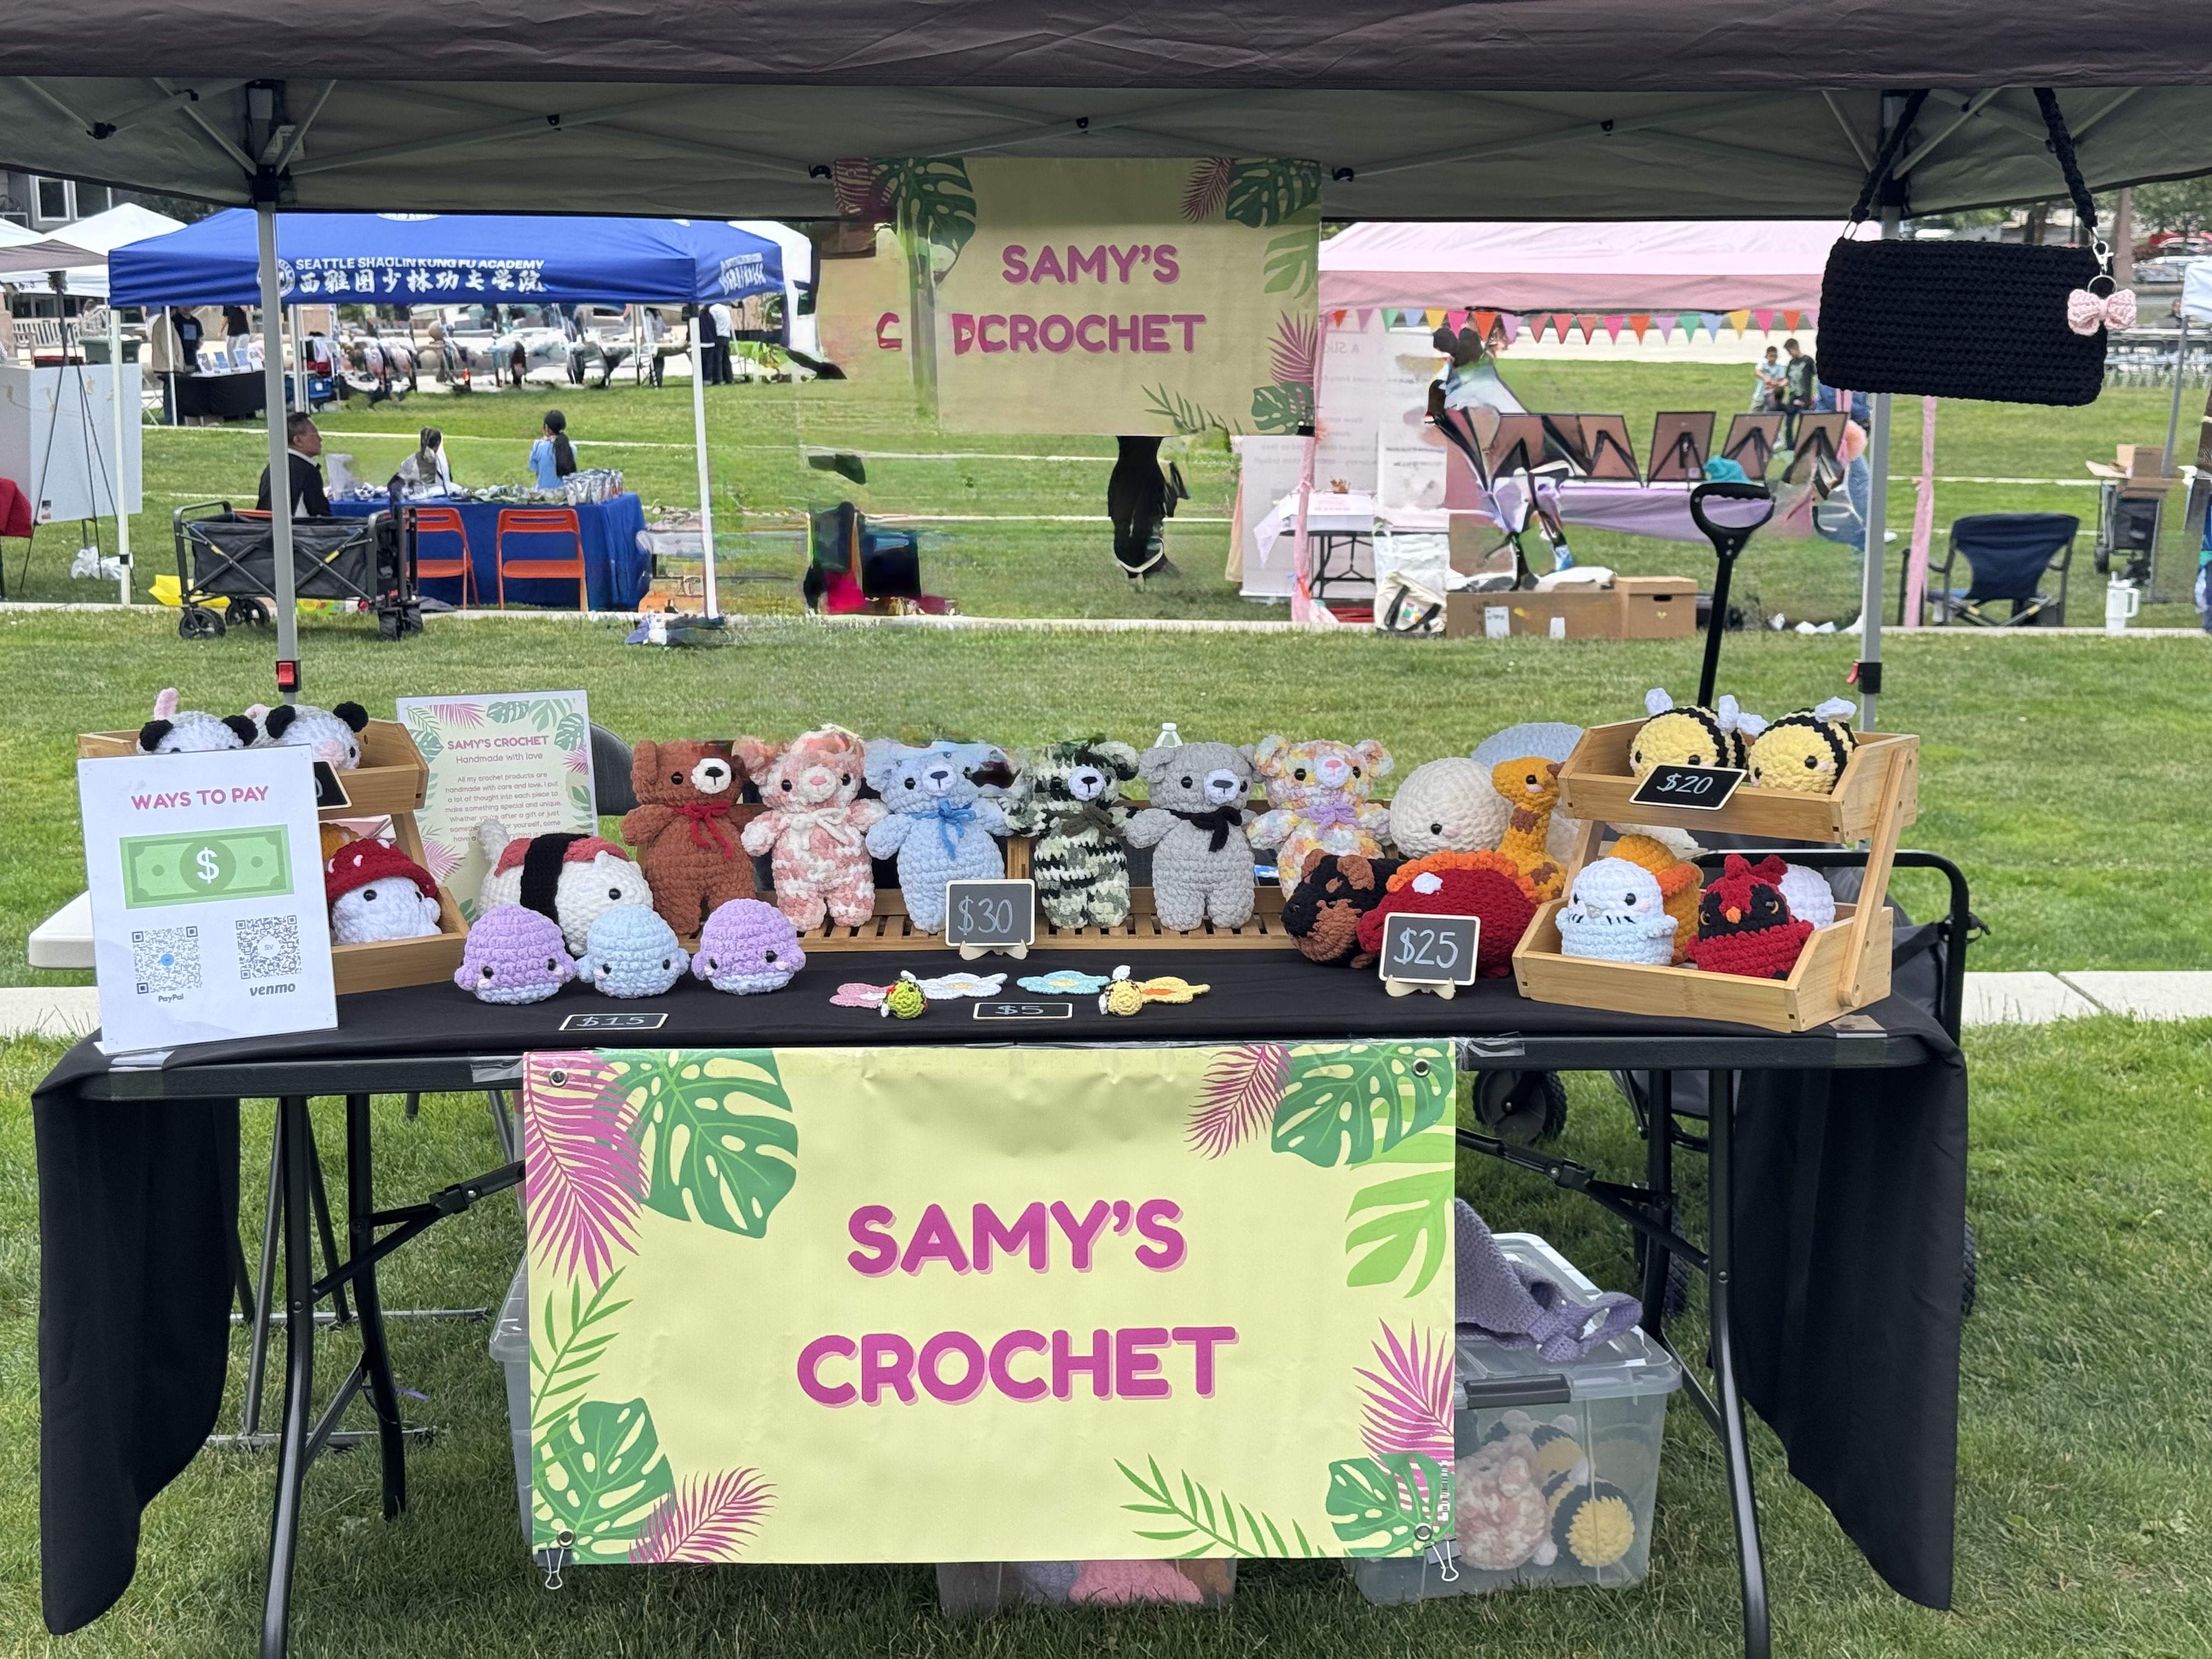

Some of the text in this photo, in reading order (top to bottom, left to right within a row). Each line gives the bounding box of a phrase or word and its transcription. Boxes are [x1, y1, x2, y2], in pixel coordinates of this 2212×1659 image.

[296, 256, 545, 270] SEATTLE SHAOLIN KUNG FU ACADEMY
[494, 735, 549, 748] CROCHET
[456, 752, 543, 764] Handmade with love
[505, 772, 534, 781] products
[1656, 772, 1714, 794] $20
[131, 786, 269, 810] WAYS TO PAY
[473, 794, 499, 803] thought
[500, 802, 524, 810] special
[546, 810, 560, 819] just
[450, 825, 481, 833] somethin
[958, 895, 1013, 936] $30
[1393, 927, 1459, 969] $25
[250, 983, 296, 997] venmo
[158, 993, 184, 1003] PayPal
[995, 1005, 1044, 1015] $5
[577, 1016, 646, 1027] $15
[797, 1325, 1240, 1409] CROCHET
